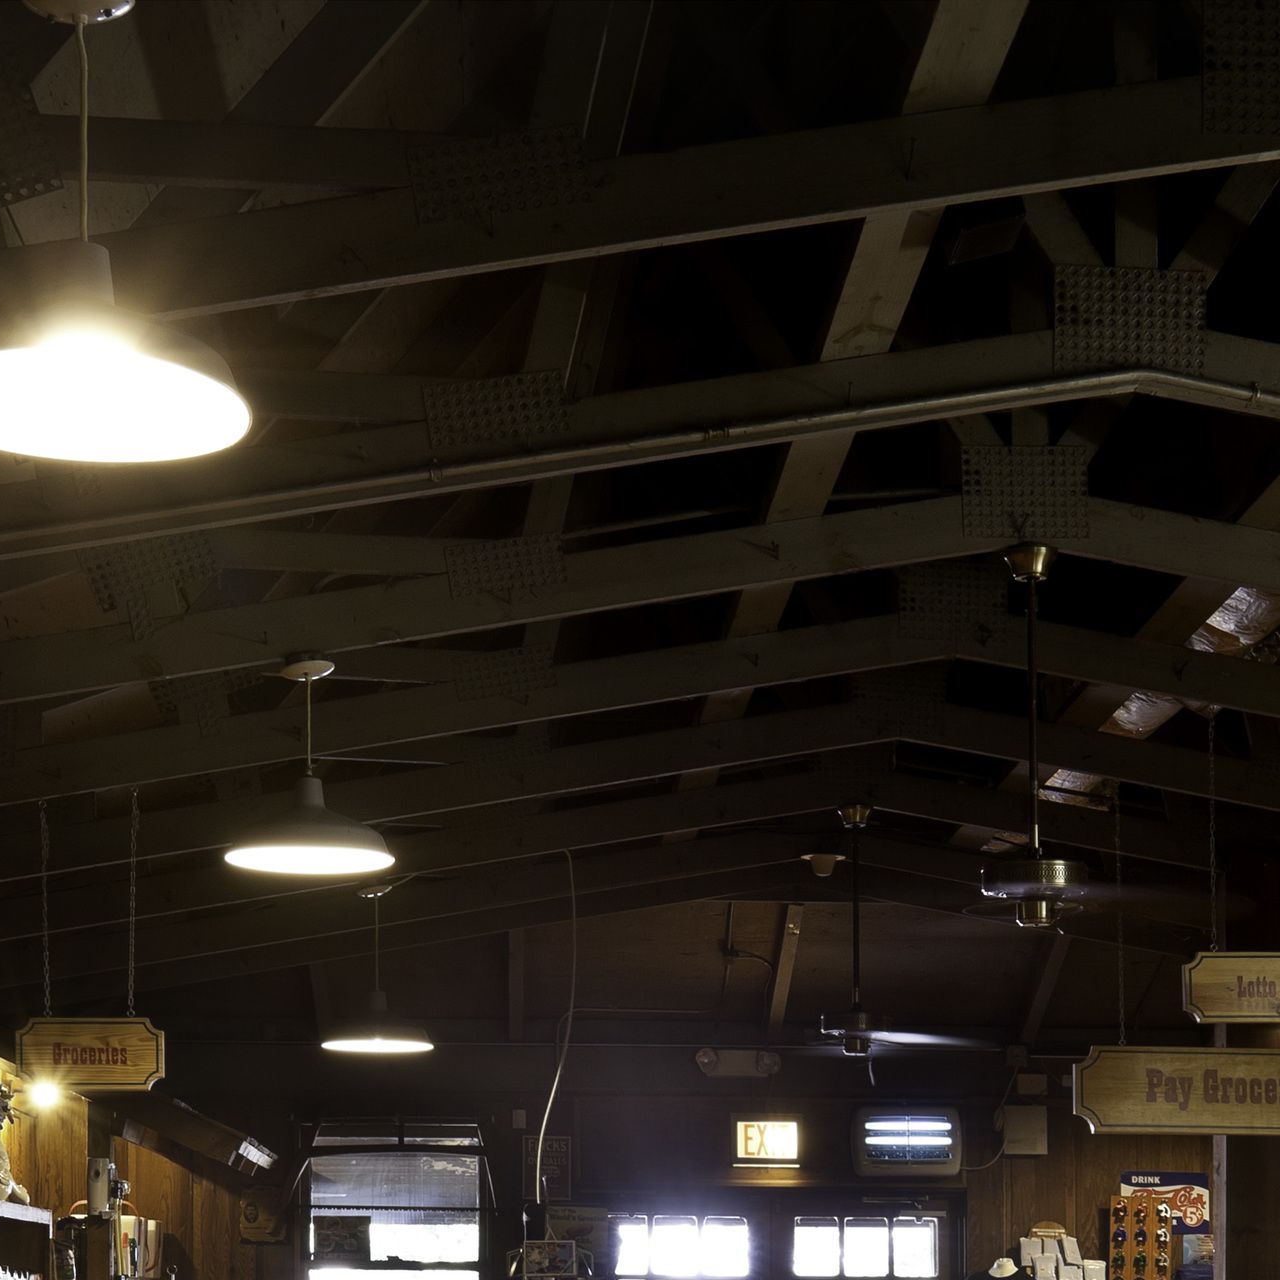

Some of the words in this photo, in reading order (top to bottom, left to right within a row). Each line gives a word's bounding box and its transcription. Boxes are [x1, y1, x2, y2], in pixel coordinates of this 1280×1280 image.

[1236, 975, 1277, 999] Lotto
[52, 1042, 128, 1065] Groceries
[1145, 1067, 1194, 1112] Pay
[1131, 1175, 1161, 1184] DRINK
